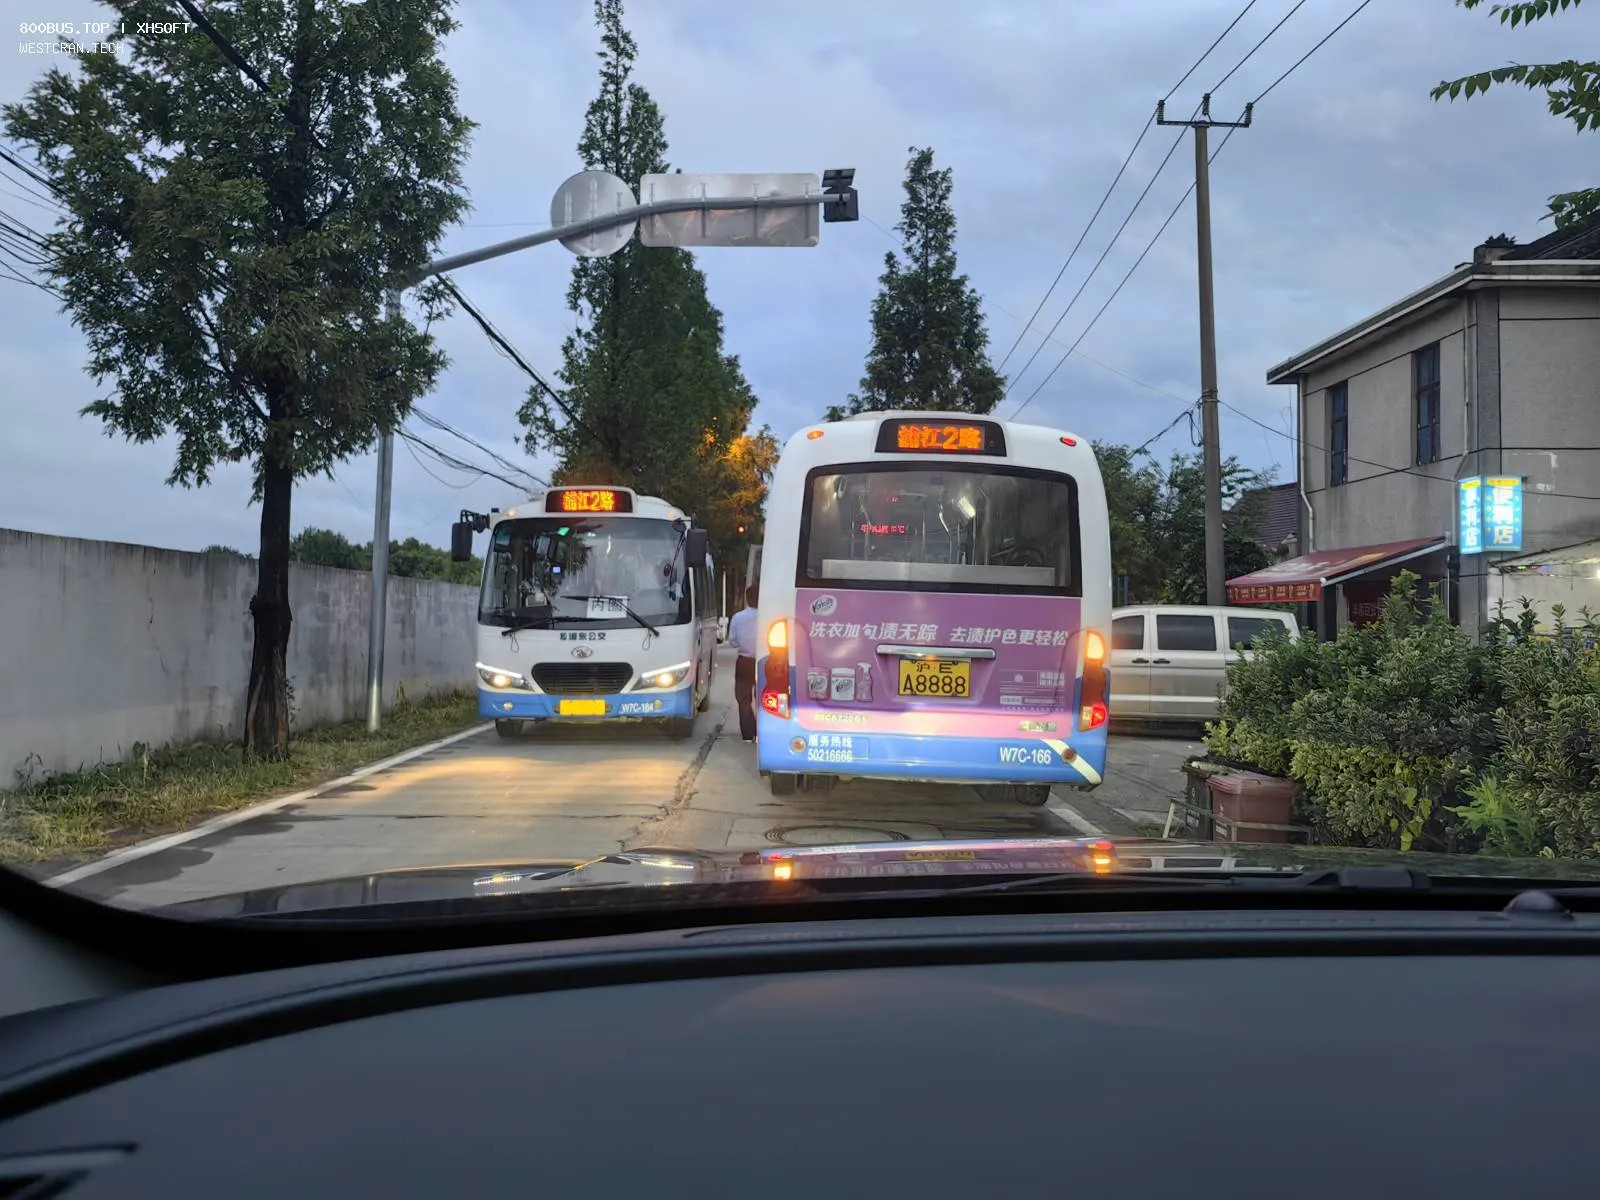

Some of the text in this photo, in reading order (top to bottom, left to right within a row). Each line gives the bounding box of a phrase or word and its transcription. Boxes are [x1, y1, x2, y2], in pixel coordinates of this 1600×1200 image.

[949, 626, 1069, 647] 去渍护色更轻松
[903, 674, 966, 694] A8888
[808, 735, 853, 748] 服务热线
[999, 746, 1052, 765] W7C-166
